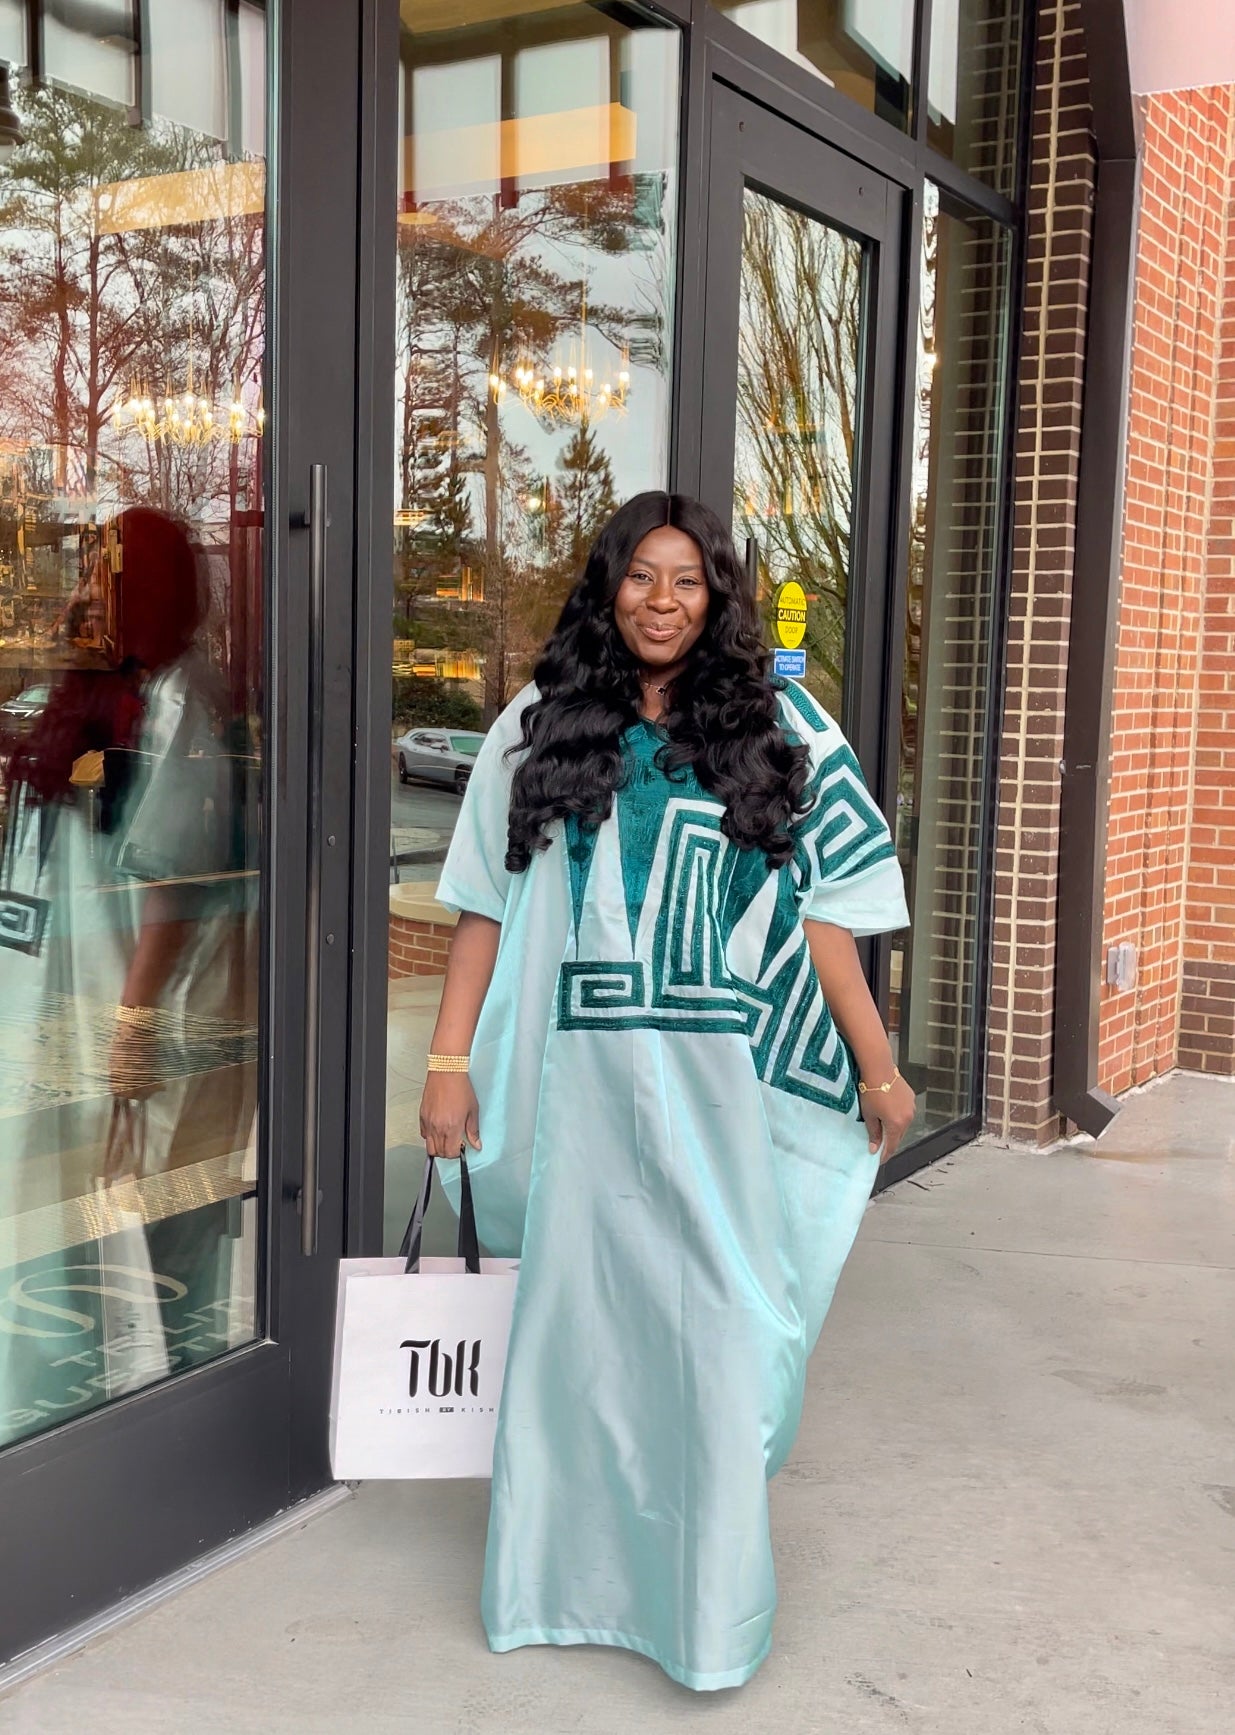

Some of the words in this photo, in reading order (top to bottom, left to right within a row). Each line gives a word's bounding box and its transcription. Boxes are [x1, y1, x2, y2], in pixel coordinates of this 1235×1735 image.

[780, 597, 805, 605] AUTOMATIC
[778, 609, 805, 622] CAUTION
[785, 626, 798, 634] DOOR
